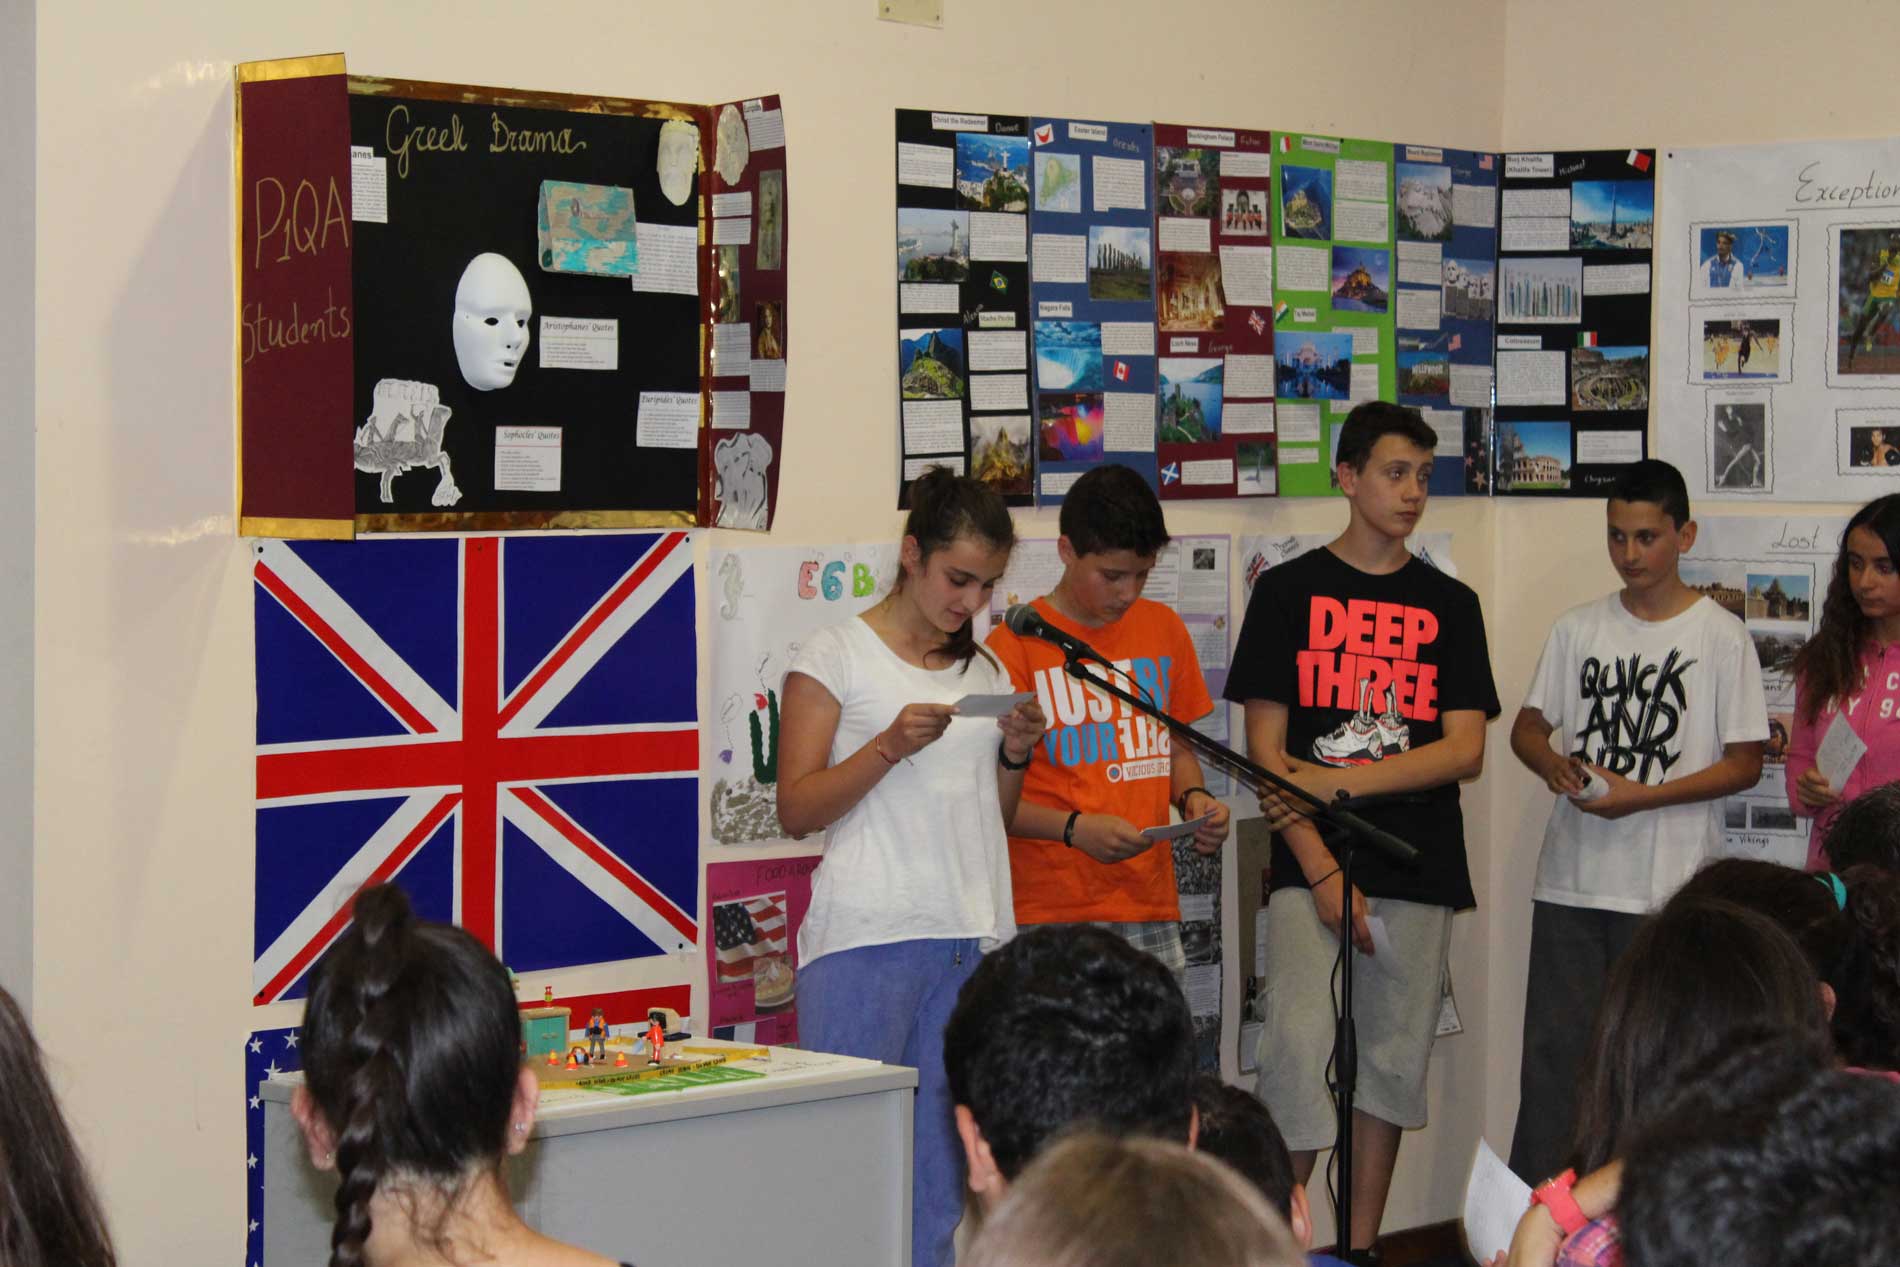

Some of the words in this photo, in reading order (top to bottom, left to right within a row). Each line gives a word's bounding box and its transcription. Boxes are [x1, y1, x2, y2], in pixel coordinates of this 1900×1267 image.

[352, 151, 372, 160] anes
[386, 104, 469, 179] Greek
[489, 111, 587, 154] Drama
[242, 285, 350, 365] Students
[1771, 521, 1820, 549] Lost
[1308, 595, 1440, 661] DEEP
[1034, 658, 1133, 729] JUST
[1296, 650, 1439, 722] THREE
[1579, 646, 1698, 714] QUICK
[1043, 722, 1119, 768] YOUR
[1575, 698, 1679, 752] AND
[1126, 763, 1156, 777] VICIOUS
